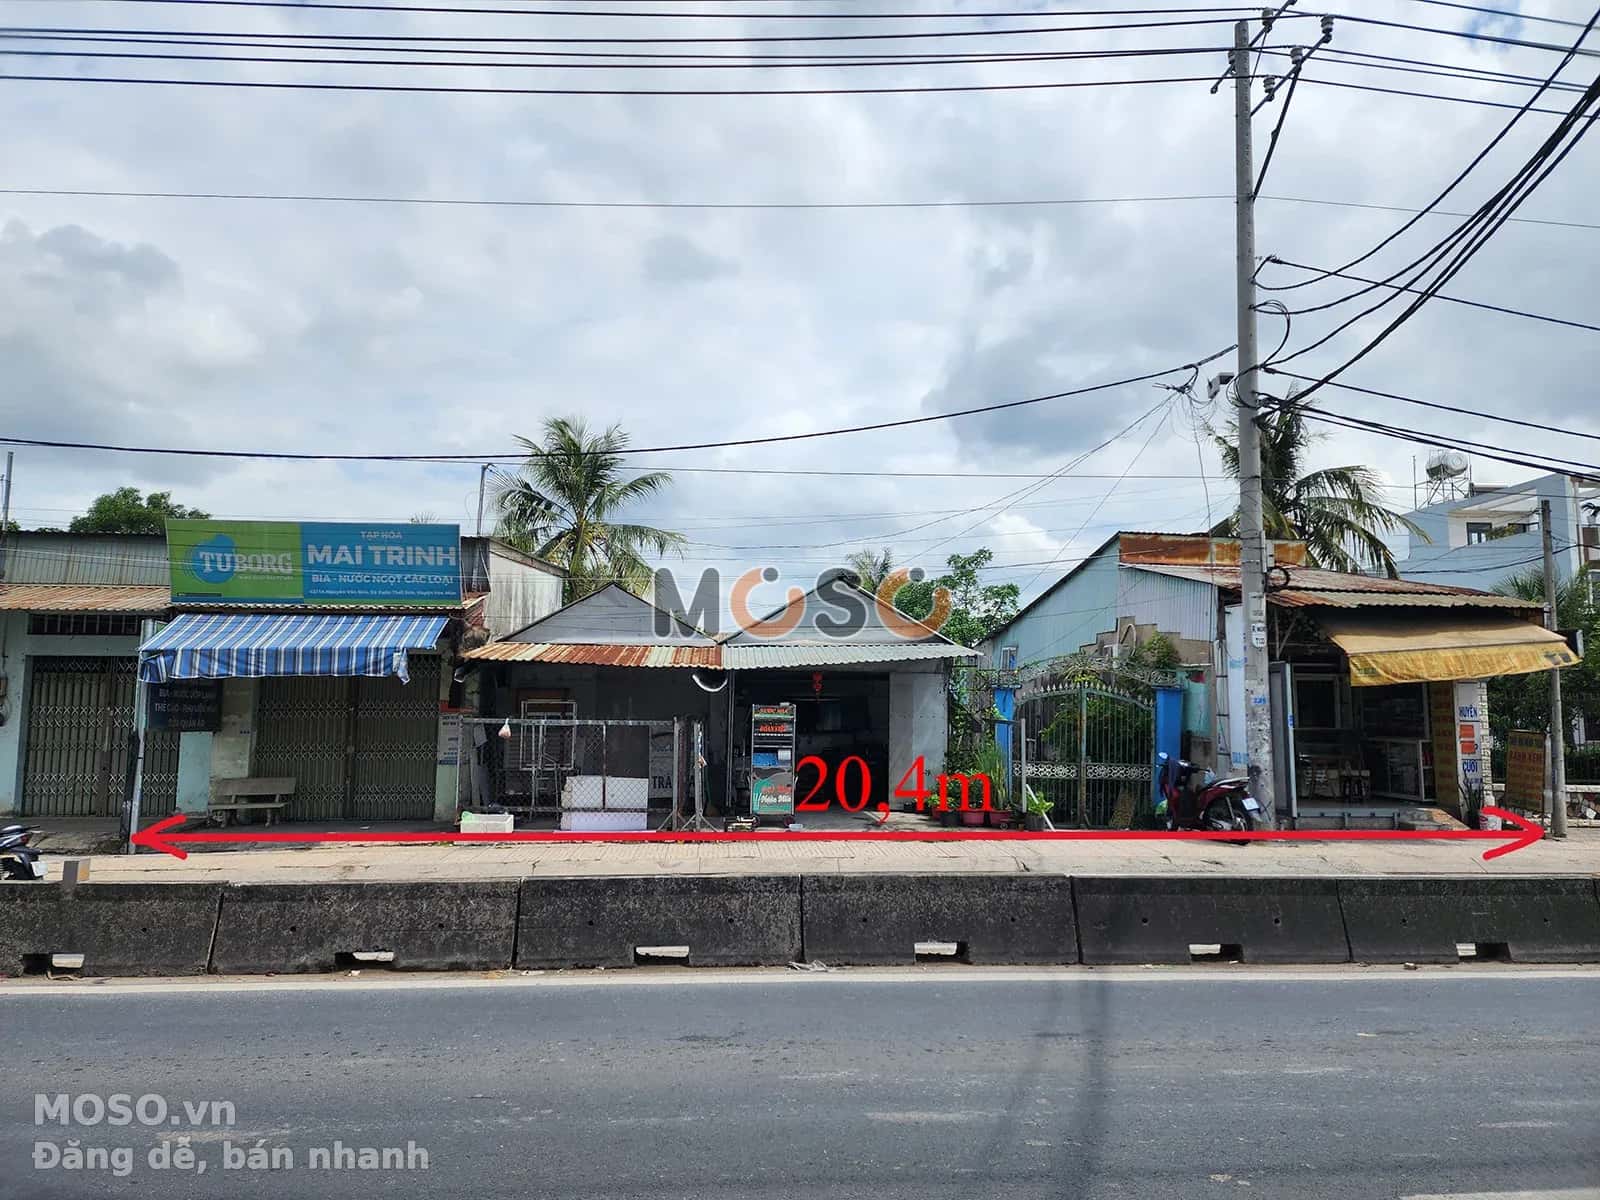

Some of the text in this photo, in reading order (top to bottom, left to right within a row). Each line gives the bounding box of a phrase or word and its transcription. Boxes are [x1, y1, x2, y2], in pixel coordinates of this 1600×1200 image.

[200, 550, 293, 575] TUBORG
[307, 544, 457, 567] MAI TRINH
[311, 574, 331, 583] BIA
